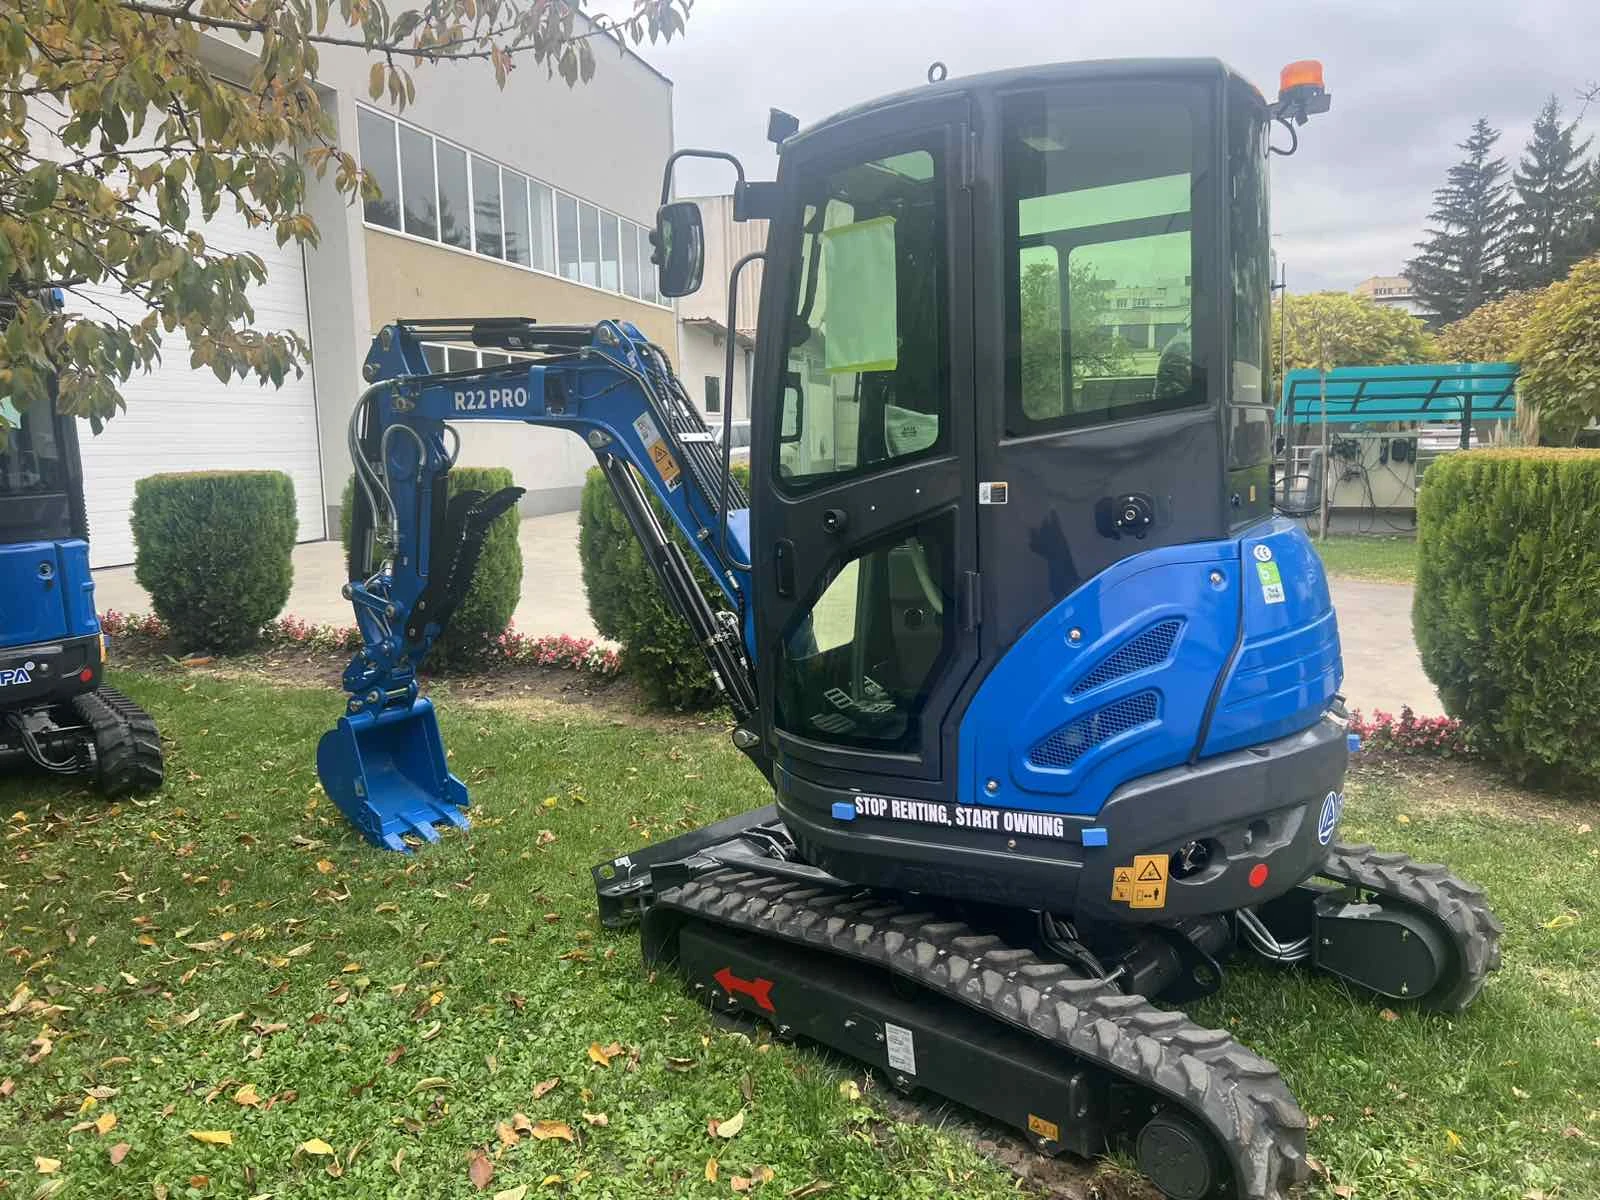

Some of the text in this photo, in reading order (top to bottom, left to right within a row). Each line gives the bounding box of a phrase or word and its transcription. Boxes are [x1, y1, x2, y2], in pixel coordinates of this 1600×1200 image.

[454, 387, 528, 411] R22 PRO
[855, 795, 1065, 838] STOP RENTING, START OWNING
